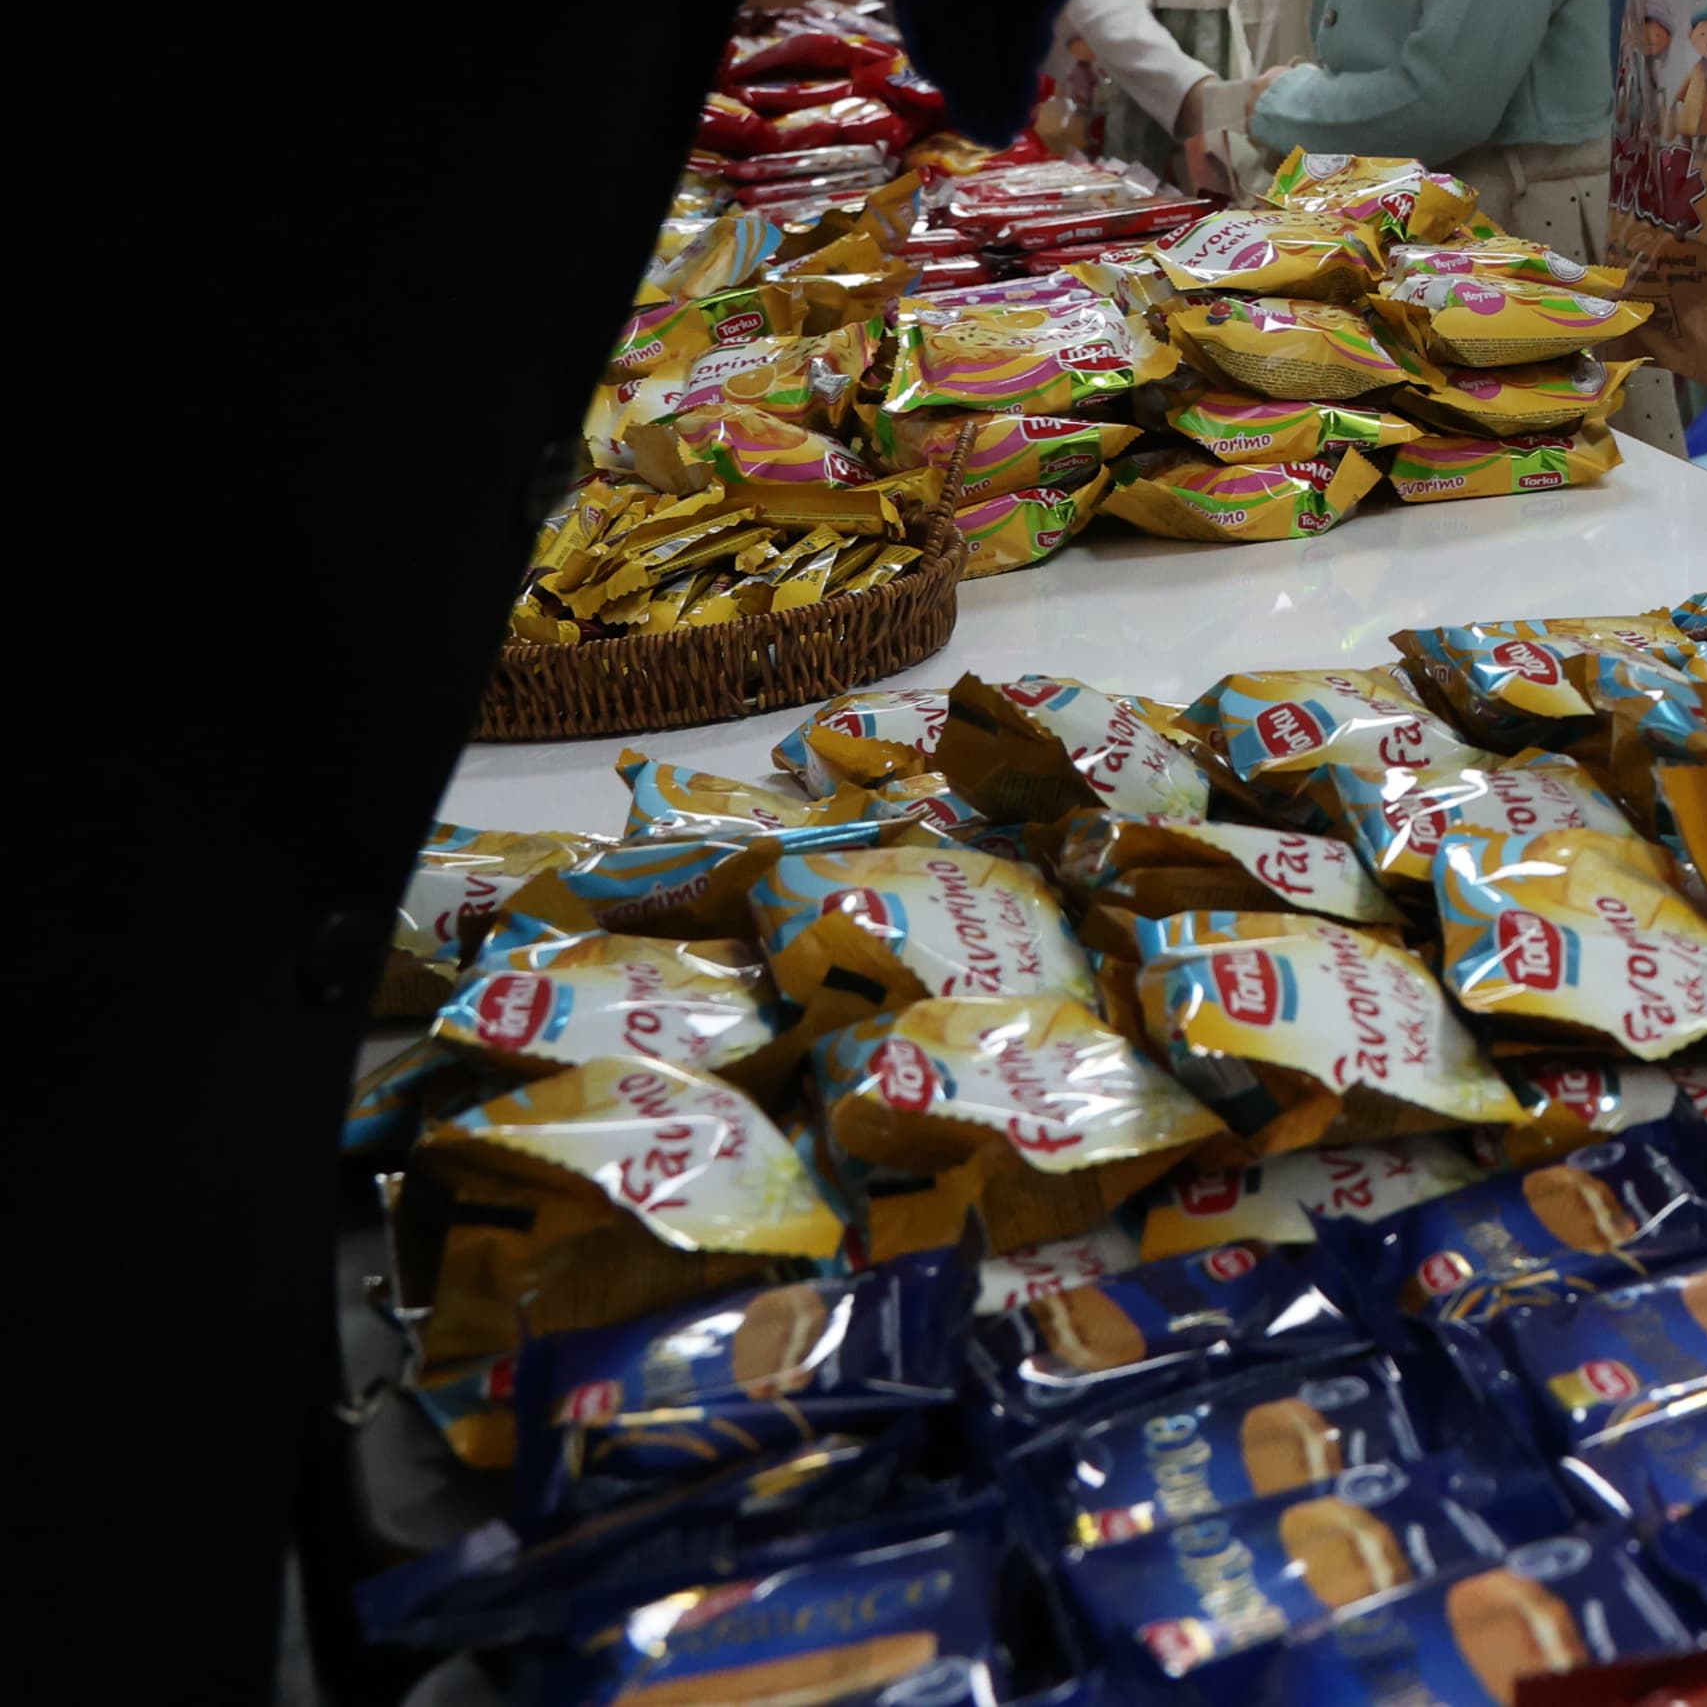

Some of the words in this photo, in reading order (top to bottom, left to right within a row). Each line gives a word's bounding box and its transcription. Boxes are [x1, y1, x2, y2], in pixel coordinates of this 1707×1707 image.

[1216, 231, 1250, 256] Kek
[720, 314, 760, 339] Torku
[1521, 475, 1560, 488] Torku
